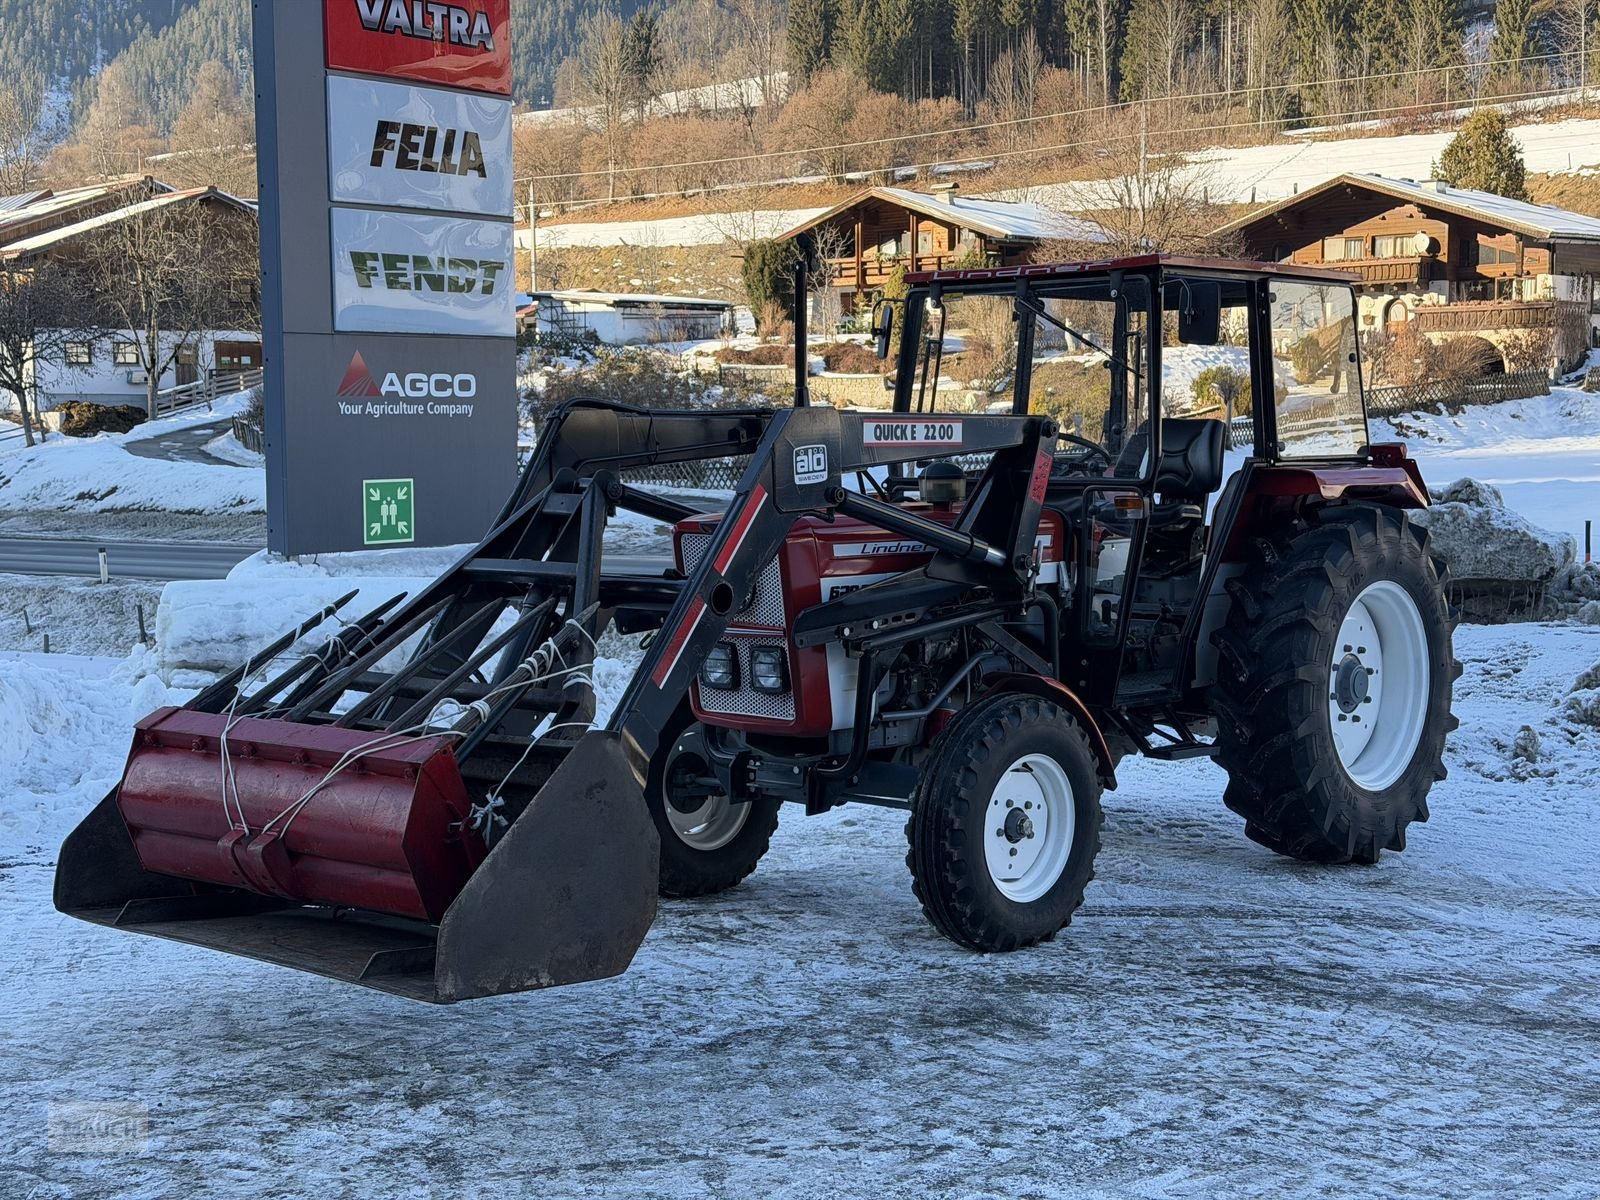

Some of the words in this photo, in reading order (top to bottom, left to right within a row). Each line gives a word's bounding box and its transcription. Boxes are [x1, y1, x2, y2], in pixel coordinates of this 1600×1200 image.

[354, 0, 495, 50] VALTRA
[370, 120, 487, 178] FELLA
[350, 251, 504, 295] FENDT
[380, 373, 476, 397] AGCO
[338, 401, 363, 415] Your
[365, 401, 424, 418] Agriculture
[427, 401, 473, 418] Company
[924, 424, 953, 440] 2200
[861, 542, 928, 554] Lindner
